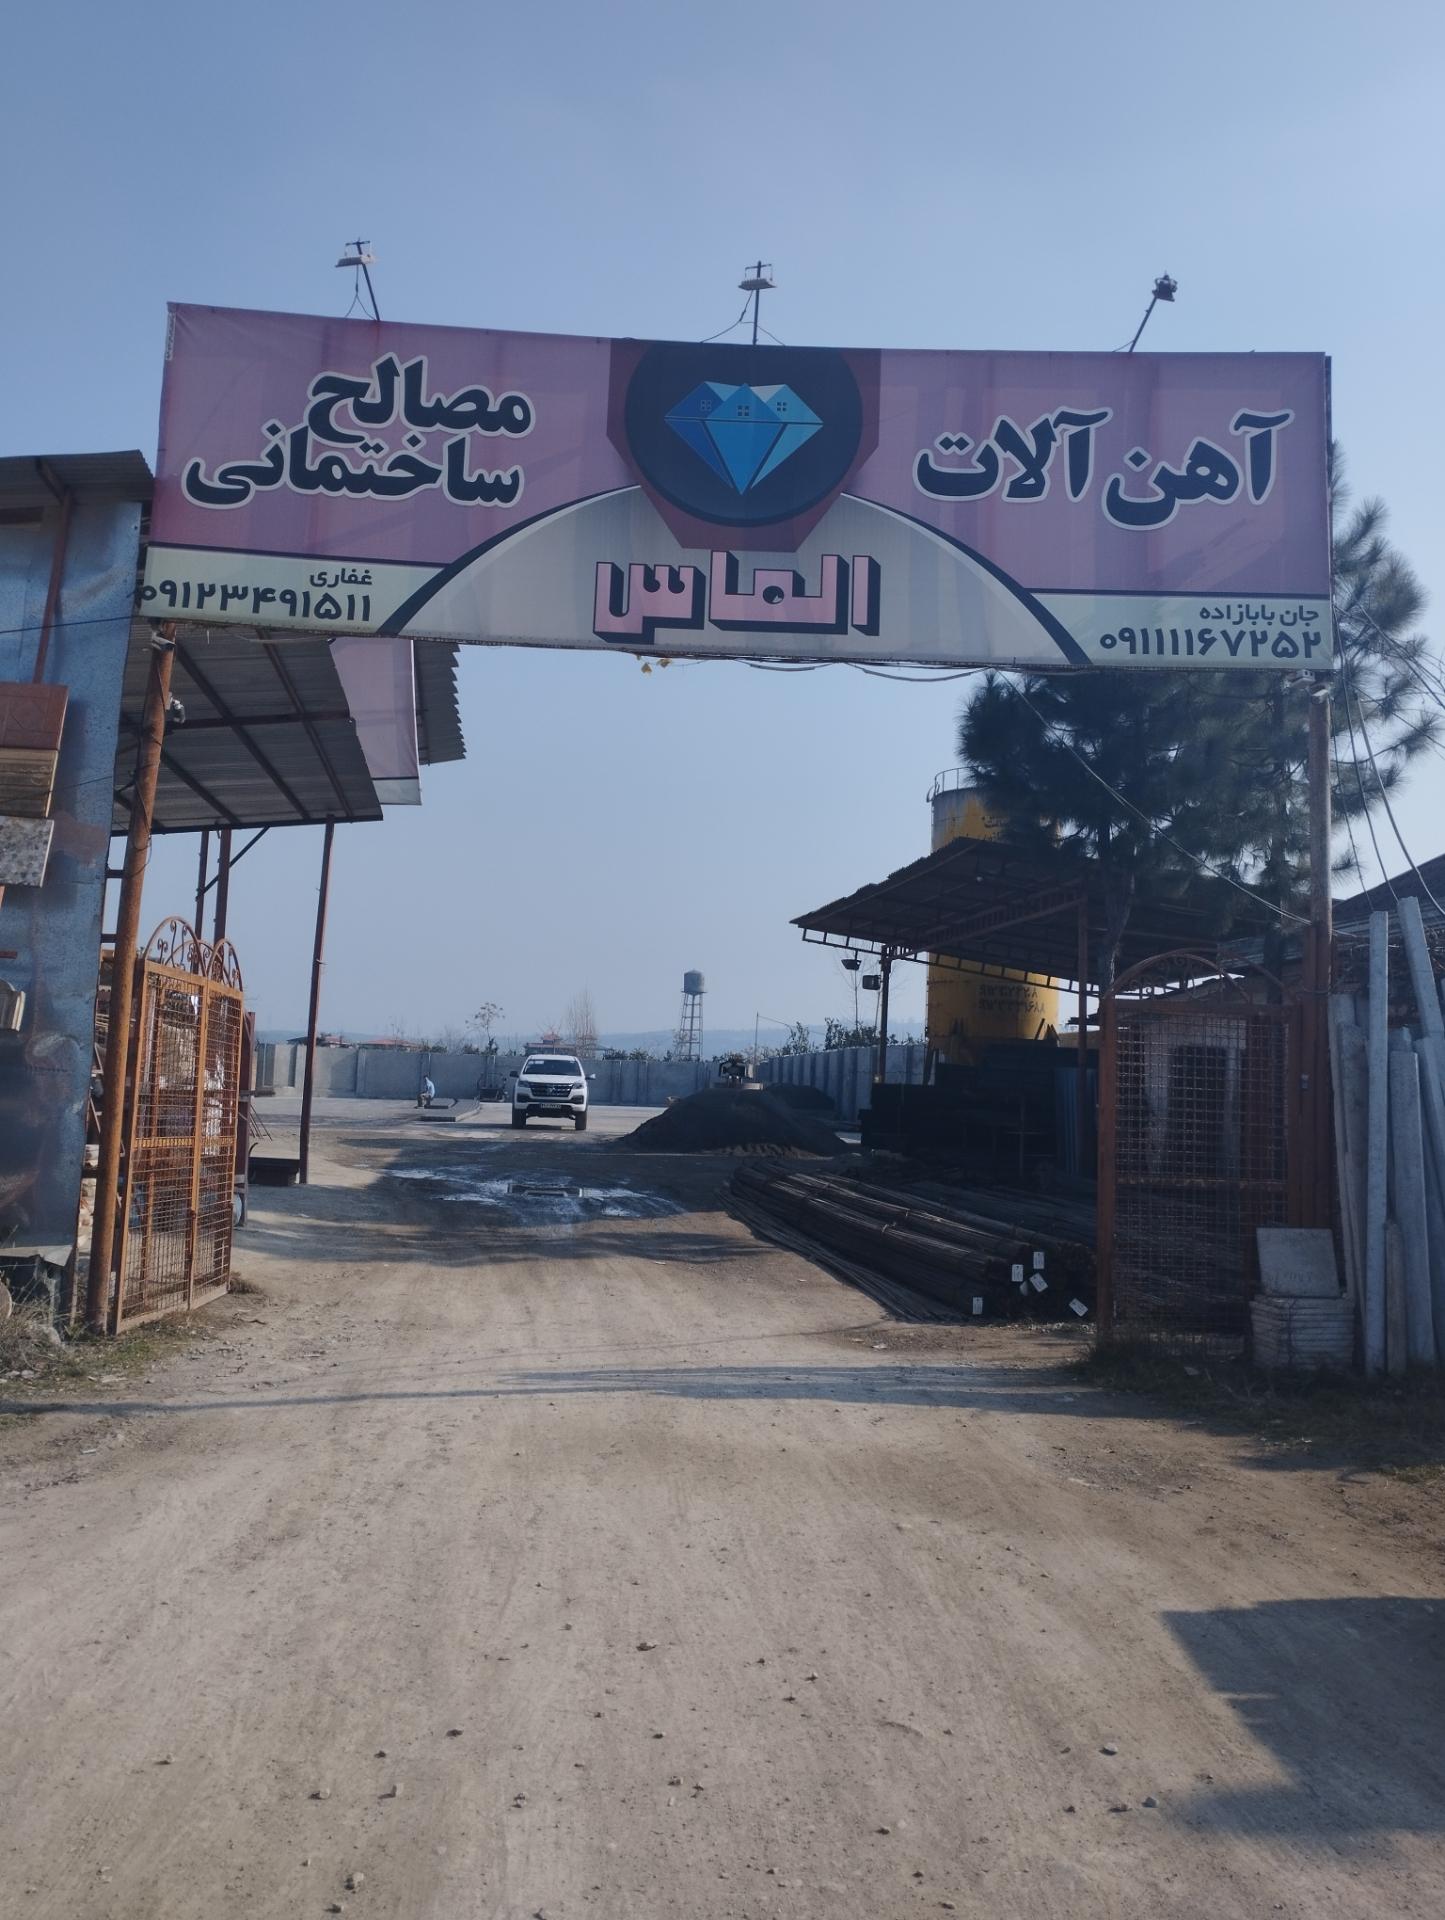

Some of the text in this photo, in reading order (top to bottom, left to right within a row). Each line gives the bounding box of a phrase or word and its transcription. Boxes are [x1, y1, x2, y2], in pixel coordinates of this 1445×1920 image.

[307, 352, 535, 446] مصالح
[182, 418, 524, 510] ساختمانی
[914, 407, 1295, 530] آهن آلات
[310, 567, 373, 589] غفاری
[593, 551, 881, 645] الماس
[1099, 626, 1322, 660] ۰۹۱۱۱۱۶۷۲۵۲
